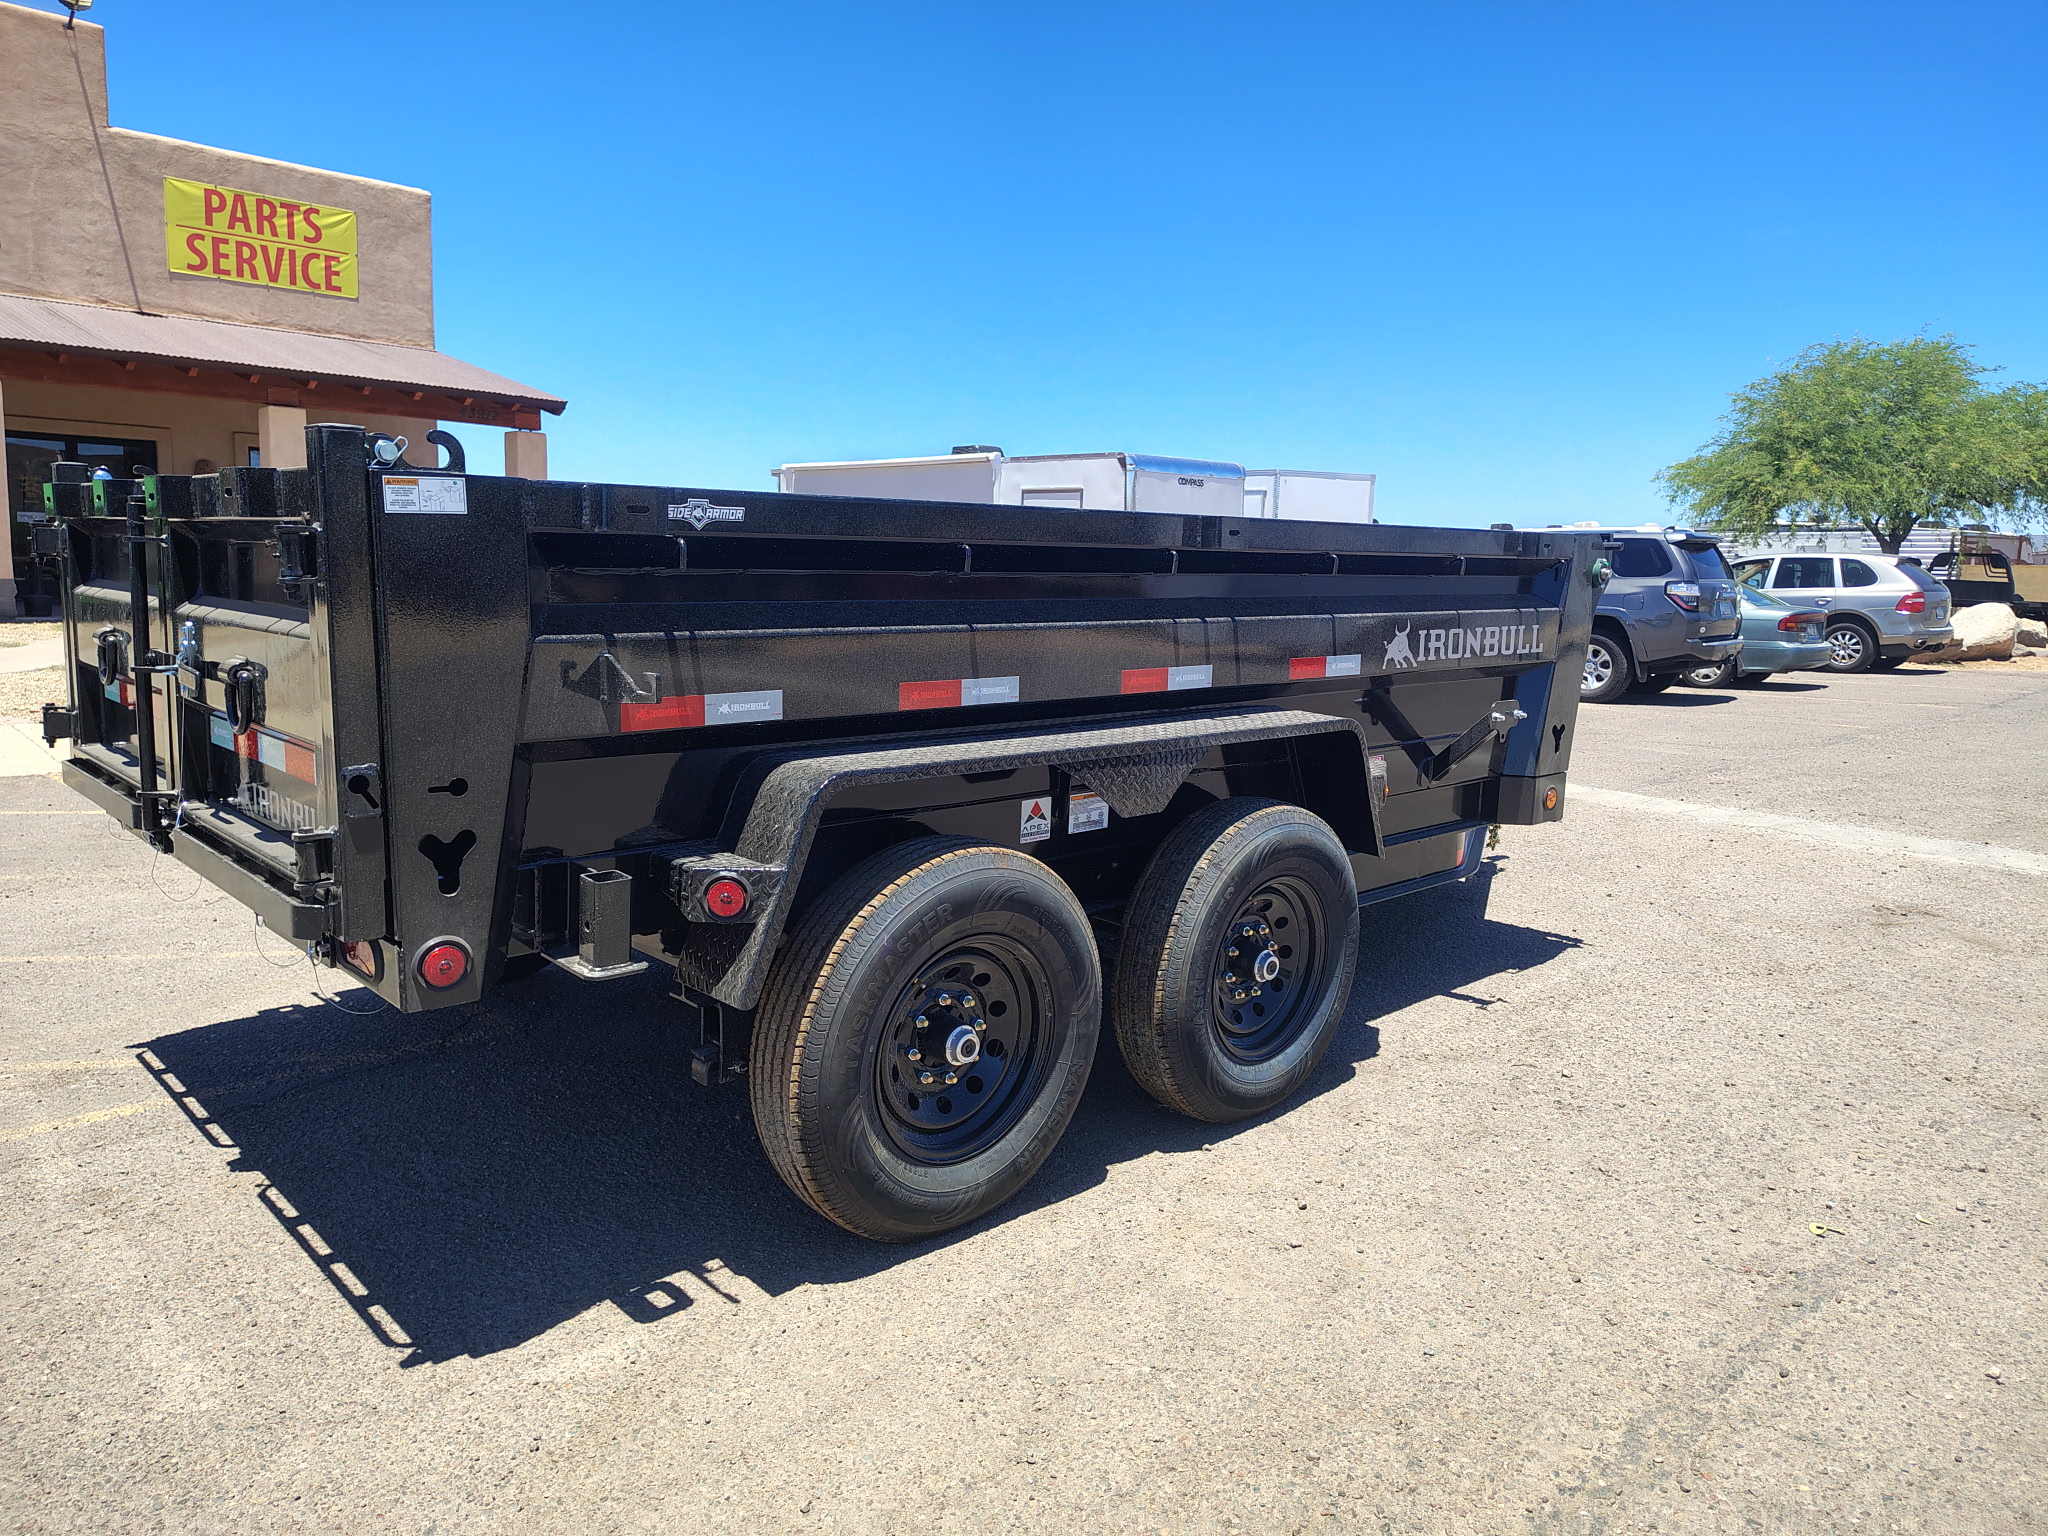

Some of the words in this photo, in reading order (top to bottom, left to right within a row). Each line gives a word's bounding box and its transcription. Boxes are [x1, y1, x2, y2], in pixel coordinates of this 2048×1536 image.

[204, 188, 323, 244] PARTS
[186, 233, 342, 293] SERVICE
[1178, 477, 1204, 487] COMPASS
[668, 507, 691, 518] SIDE
[706, 508, 743, 519] ARMOR
[1417, 624, 1544, 662] IRONBULL
[730, 700, 771, 711] IRONBULL
[1022, 823, 1049, 833] APEX
[1016, 1059, 1086, 1173] RAMBLER
